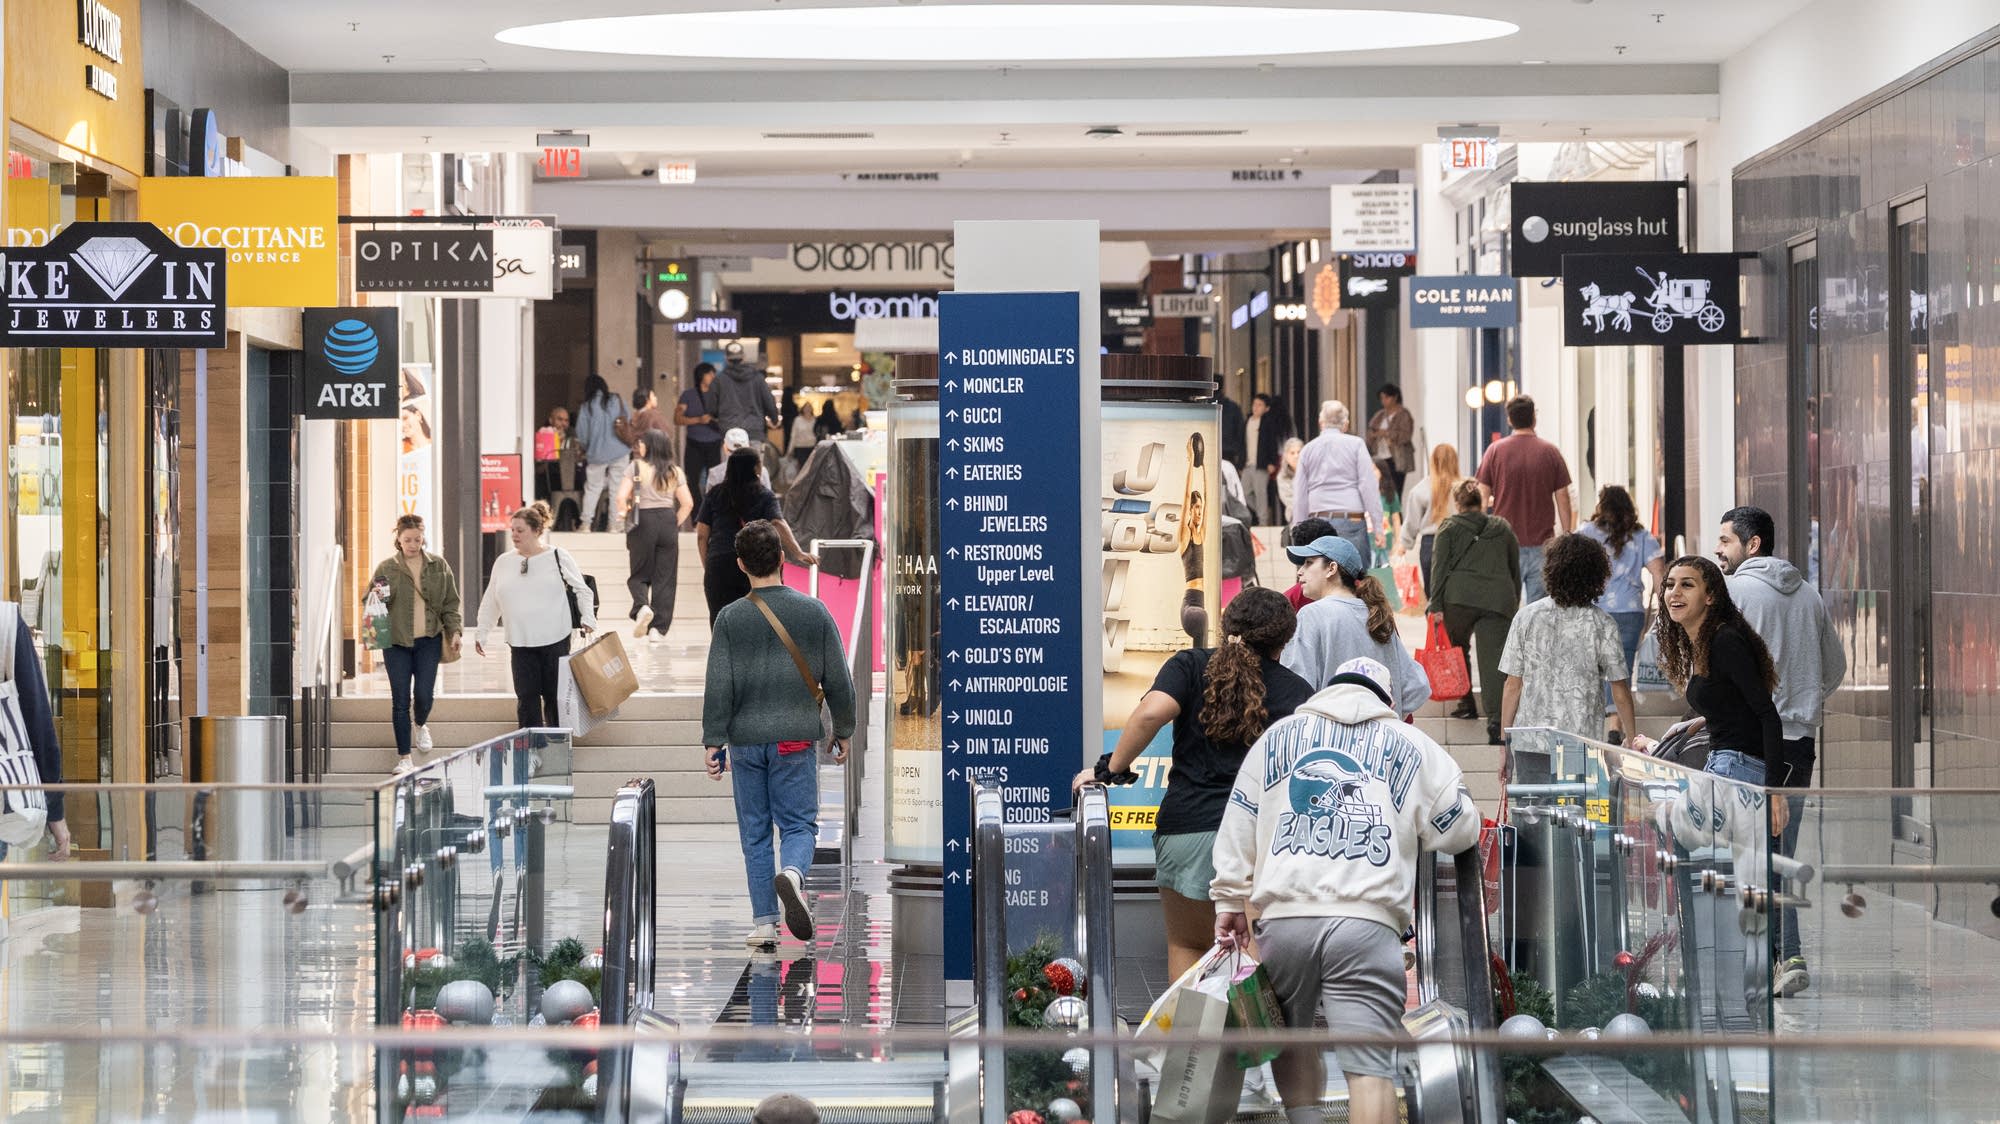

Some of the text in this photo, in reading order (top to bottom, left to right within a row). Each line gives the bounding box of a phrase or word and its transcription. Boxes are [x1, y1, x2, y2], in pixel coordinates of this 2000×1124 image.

[1452, 140, 1488, 168] EXIT
[1232, 169, 1284, 181] MONCLER
[1552, 216, 1668, 241] sunglass hut
[1415, 288, 1513, 304] COLE HAAN
[1440, 306, 1487, 314] NEW YORK
[10, 309, 212, 329] JEWELERS
[962, 348, 1075, 366] BLOOMINGDALE'S
[963, 378, 1024, 394] MONCLER
[317, 383, 386, 407] AT&T
[963, 408, 1002, 424] GUCCI
[963, 437, 1004, 453] SKIMS
[964, 465, 1022, 481] EATERIES
[964, 495, 1008, 512] BHINDI
[980, 516, 1048, 532] JEWELERS
[964, 544, 1042, 561] RESTROOMS
[978, 565, 1054, 584] Upper Level
[903, 585, 922, 595] YORK
[980, 618, 1061, 634] ESCALATORS
[965, 647, 1043, 664] GOLD'S GYM
[965, 677, 1068, 692] ANTHROPOLOGIE
[965, 710, 1013, 726] UNIQLO
[966, 738, 1049, 754] DIN TAI FUNG
[901, 767, 920, 778] OPEN
[1006, 807, 1050, 823] GOODS
[1005, 838, 1039, 854] BOSS
[1271, 811, 1392, 867] EAGLES
[1041, 890, 1049, 906] B
